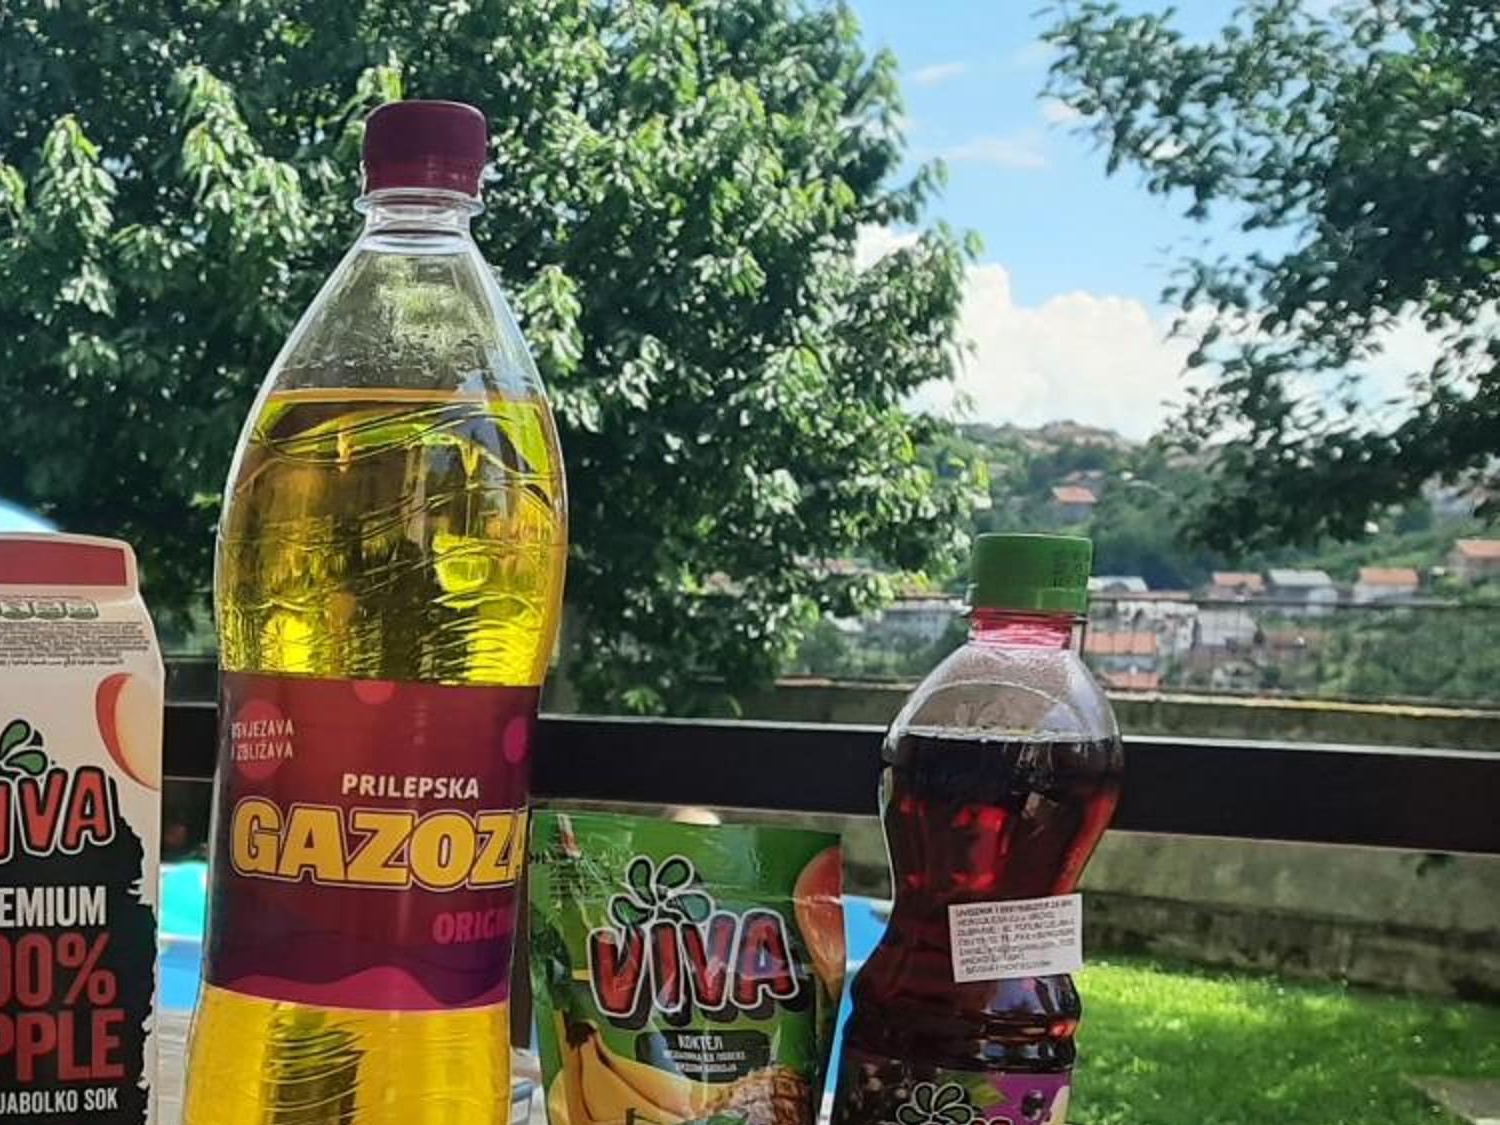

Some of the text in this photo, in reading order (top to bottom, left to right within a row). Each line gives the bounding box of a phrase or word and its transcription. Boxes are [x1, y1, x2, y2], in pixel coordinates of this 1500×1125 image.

[341, 773, 480, 799] PRILEPSKA
[588, 909, 798, 1018] VIVA
[83, 1087, 118, 1111] SOK
